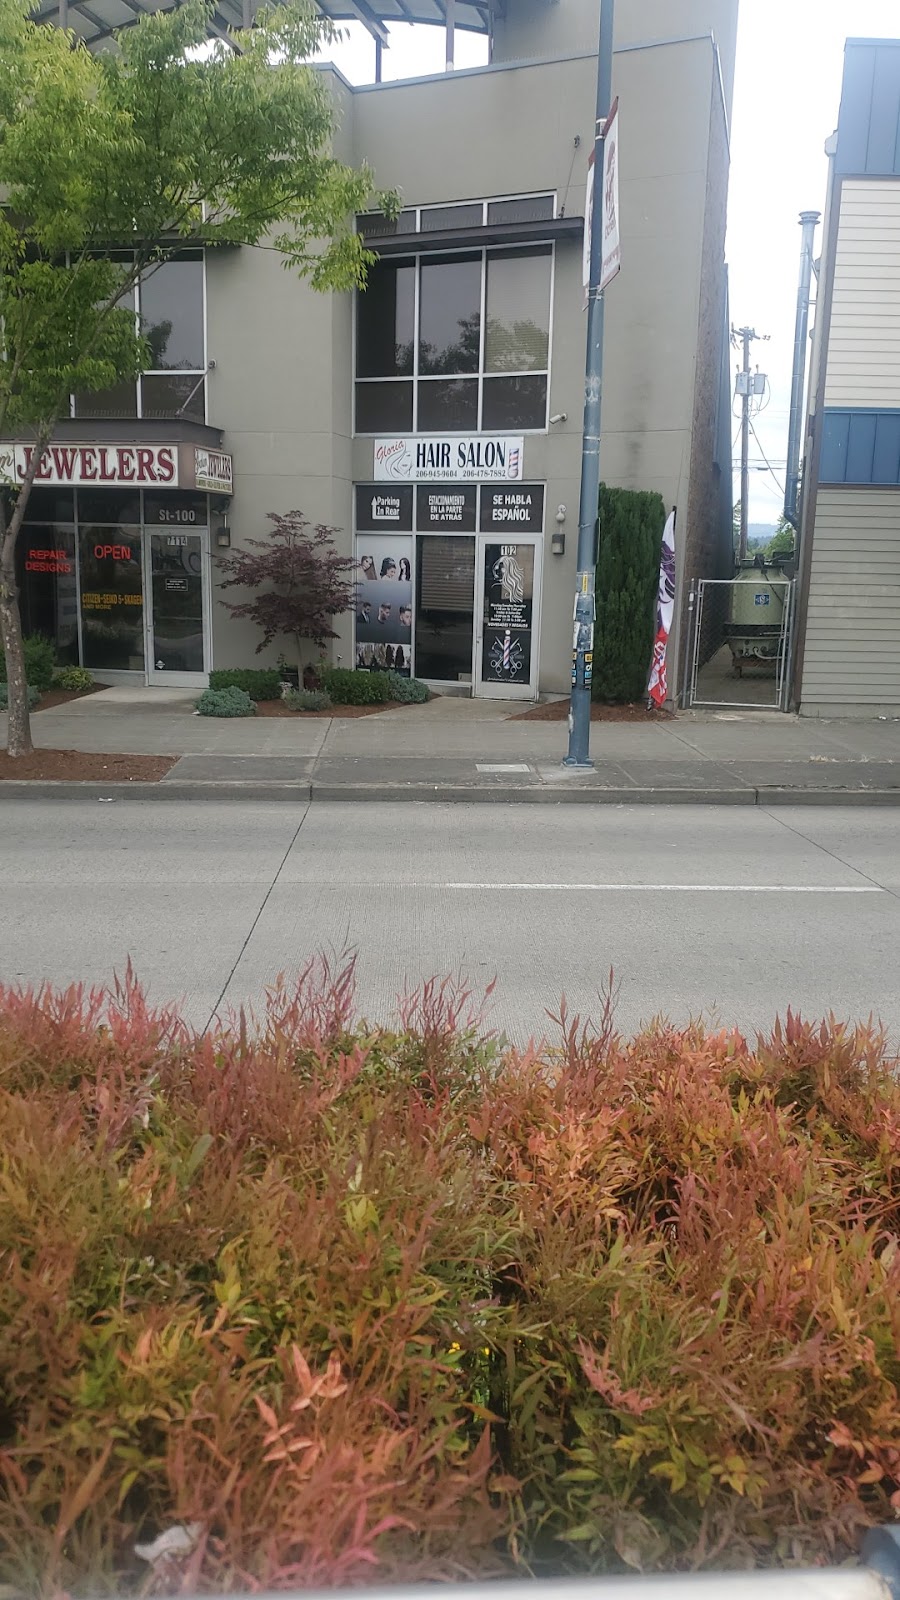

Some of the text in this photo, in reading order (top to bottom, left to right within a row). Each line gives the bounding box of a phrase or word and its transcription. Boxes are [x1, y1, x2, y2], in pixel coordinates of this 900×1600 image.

[375, 440, 405, 465] Gloria
[416, 441, 506, 468] HAIR SALON
[17, 447, 174, 481] JEWELERS
[416, 469, 506, 478] 206-945-9604 206-478-7882
[377, 496, 400, 508] Parking
[428, 495, 465, 506] ESTACIONAMIENTO
[493, 495, 532, 505] SE HABLA
[158, 509, 196, 522] St-100
[377, 507, 400, 516] In Rear
[445, 506, 462, 514] PARTE
[492, 506, 531, 521] ESPAÑOL
[29, 549, 67, 560] REPAIR
[93, 544, 131, 560] OPEN
[502, 546, 516, 555] 102
[25, 561, 71, 573] DESIGNS
